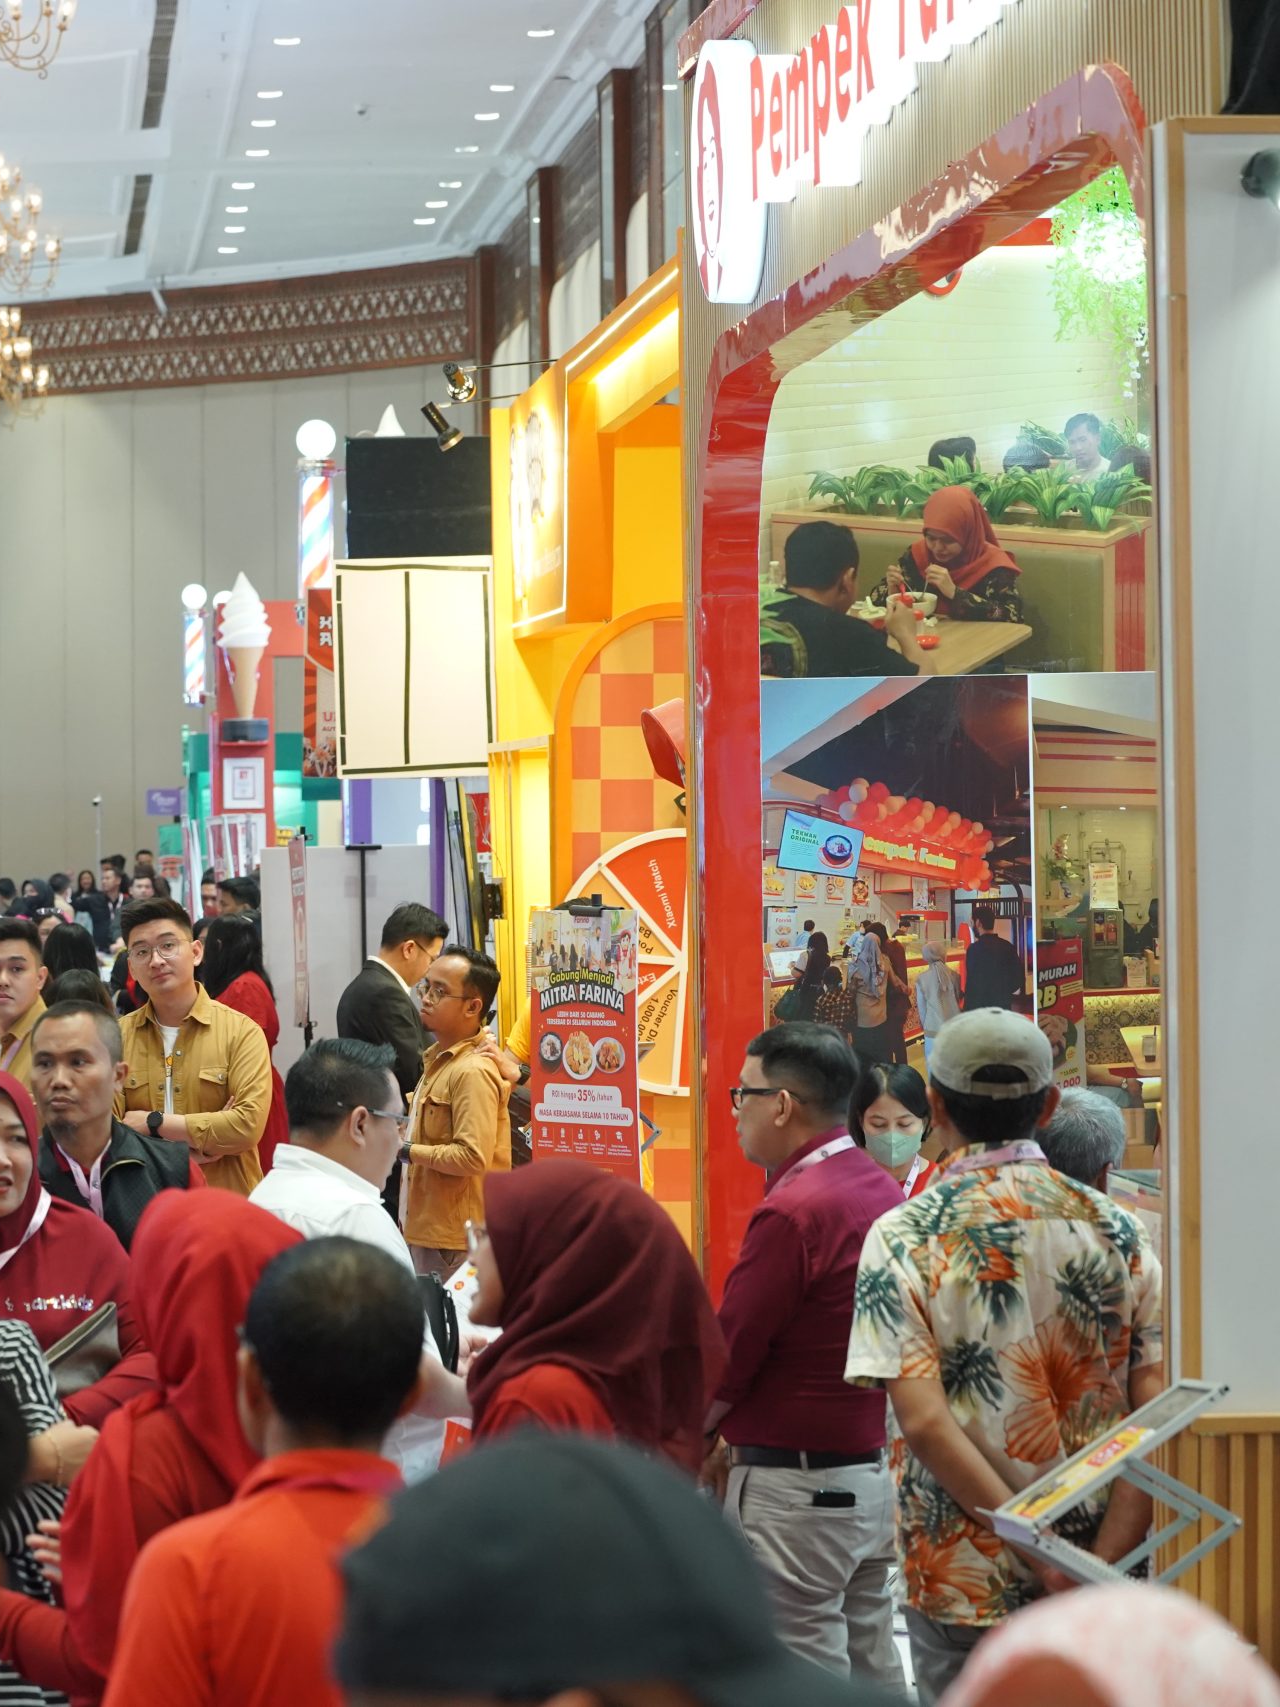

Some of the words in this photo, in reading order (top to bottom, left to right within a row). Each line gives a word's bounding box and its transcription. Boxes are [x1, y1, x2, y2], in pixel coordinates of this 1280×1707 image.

[750, 0, 875, 202] Pempek
[790, 835, 820, 846] ORIGINAL
[648, 858, 665, 893] Watch
[658, 892, 677, 929] Xiaomi
[550, 970, 580, 984] Gabung
[581, 968, 615, 986] Menjadi
[1039, 963, 1077, 982] MURAH
[540, 983, 576, 1011] MITRA
[579, 983, 624, 1012] FARINA
[653, 989, 678, 1028] Voucher
[560, 1090, 577, 1100] hingga
[577, 1089, 596, 1102] 35%
[596, 1093, 613, 1101] /tahun
[539, 1108, 552, 1117] MASA
[553, 1109, 581, 1118] KERJASAMA
[582, 1111, 601, 1119] SELAMA
[602, 1112, 609, 1120] 10
[610, 1112, 629, 1121] TAHUN
